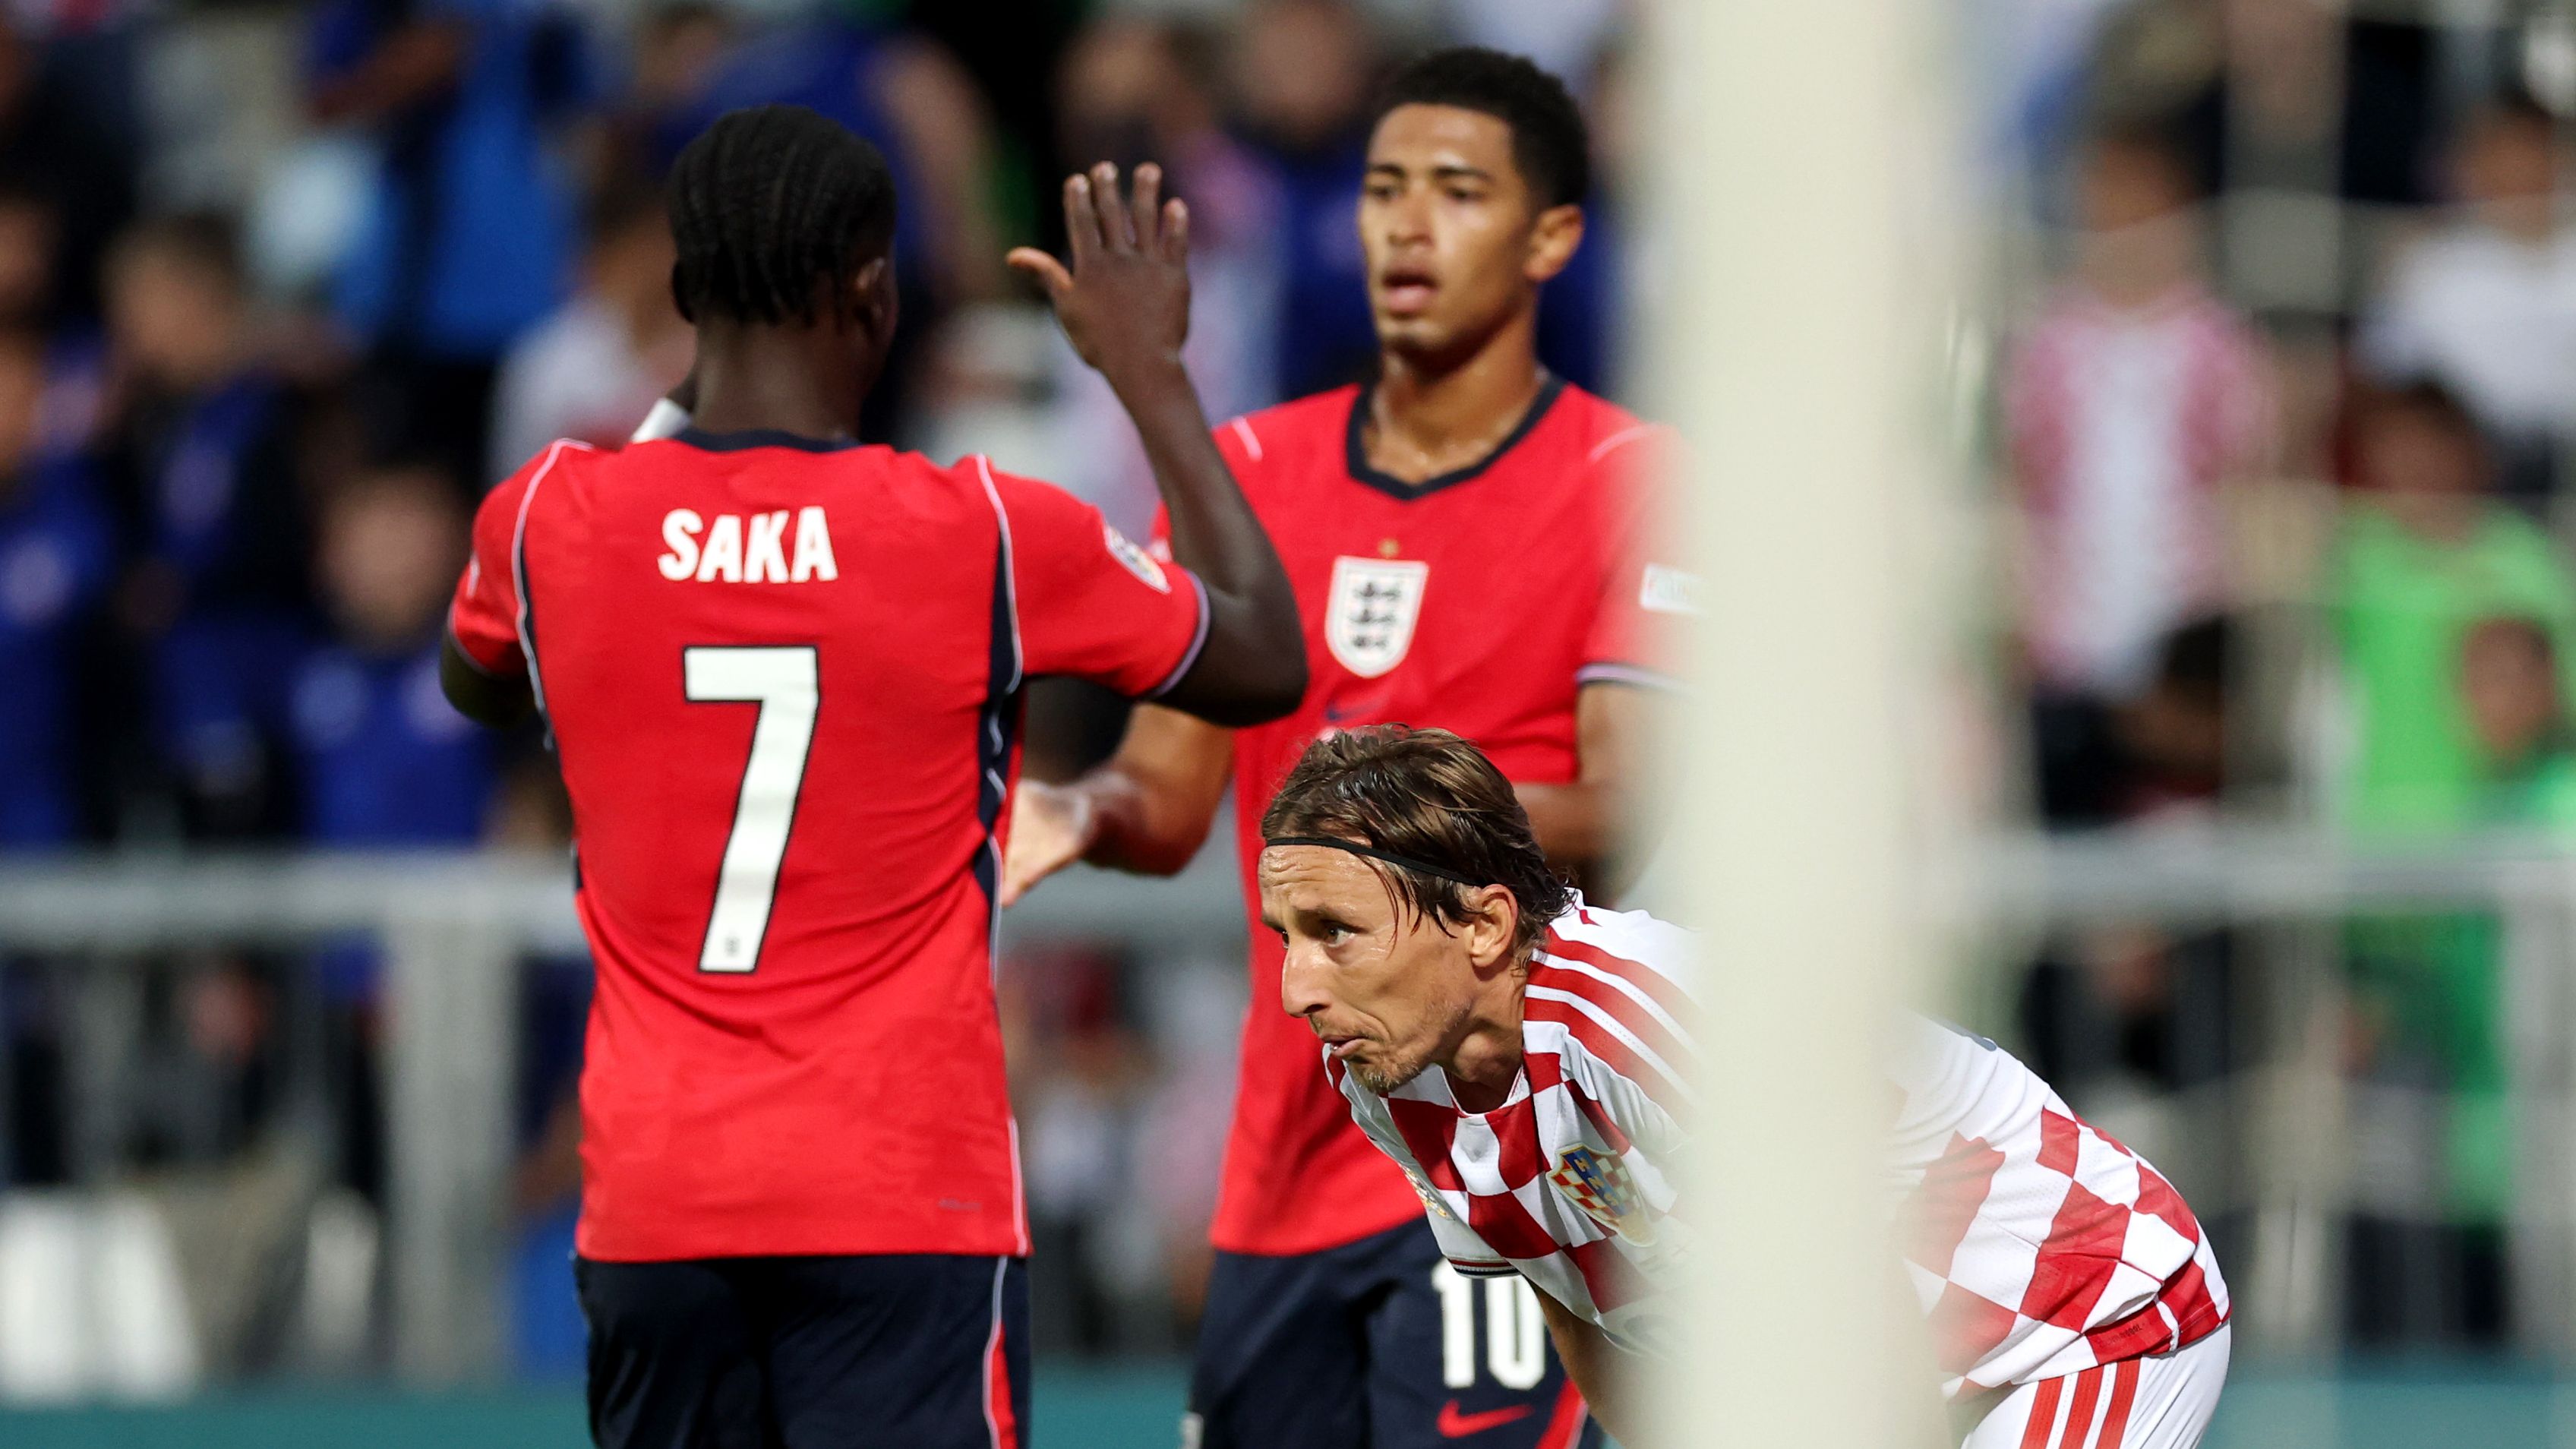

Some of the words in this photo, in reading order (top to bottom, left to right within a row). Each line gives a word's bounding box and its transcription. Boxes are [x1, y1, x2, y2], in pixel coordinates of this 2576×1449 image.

[658, 507, 838, 583] SAKA
[684, 645, 819, 973] 7
[1432, 1256, 1546, 1391] 10
